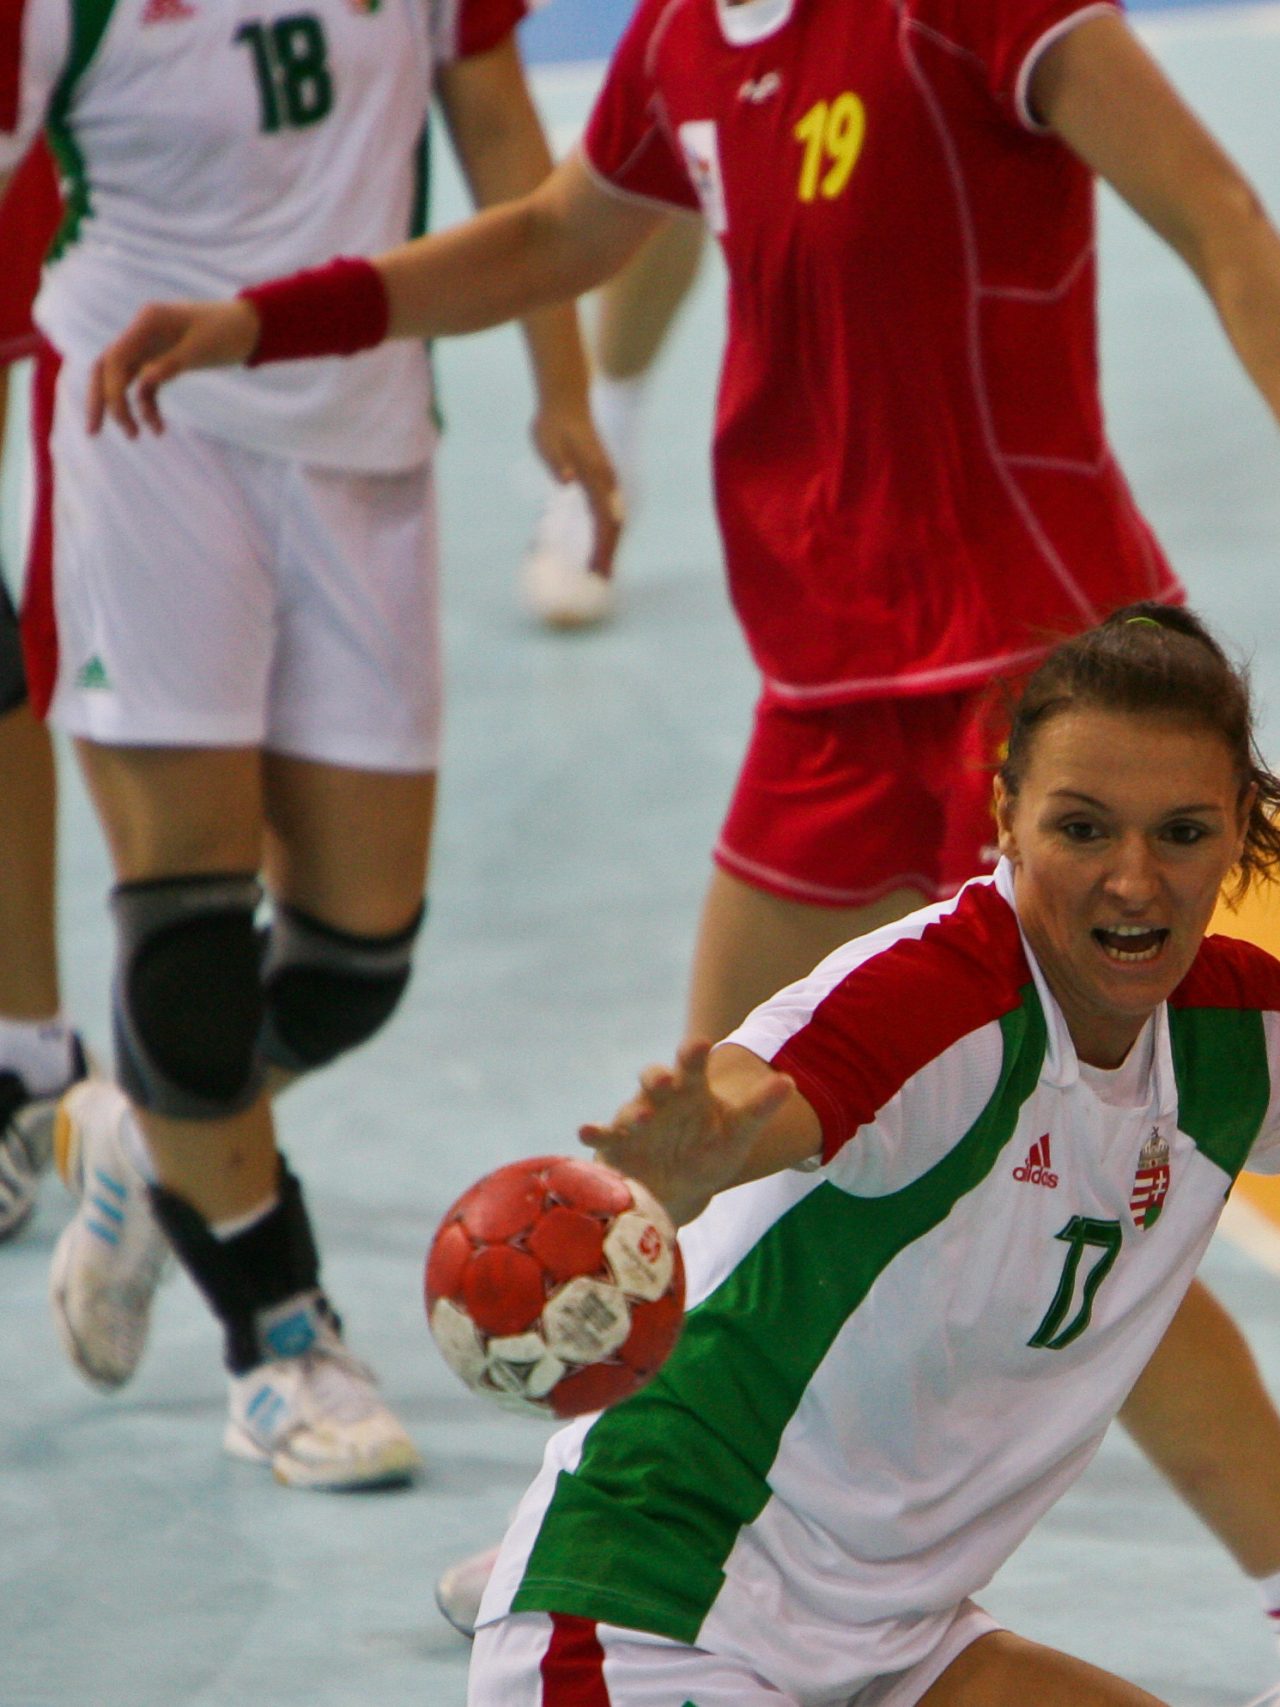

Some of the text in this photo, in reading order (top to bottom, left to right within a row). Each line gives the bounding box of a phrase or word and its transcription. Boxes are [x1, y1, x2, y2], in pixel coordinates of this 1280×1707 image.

[232, 13, 334, 134] 18
[793, 91, 866, 202] 19
[1026, 1214, 1122, 1350] 17
